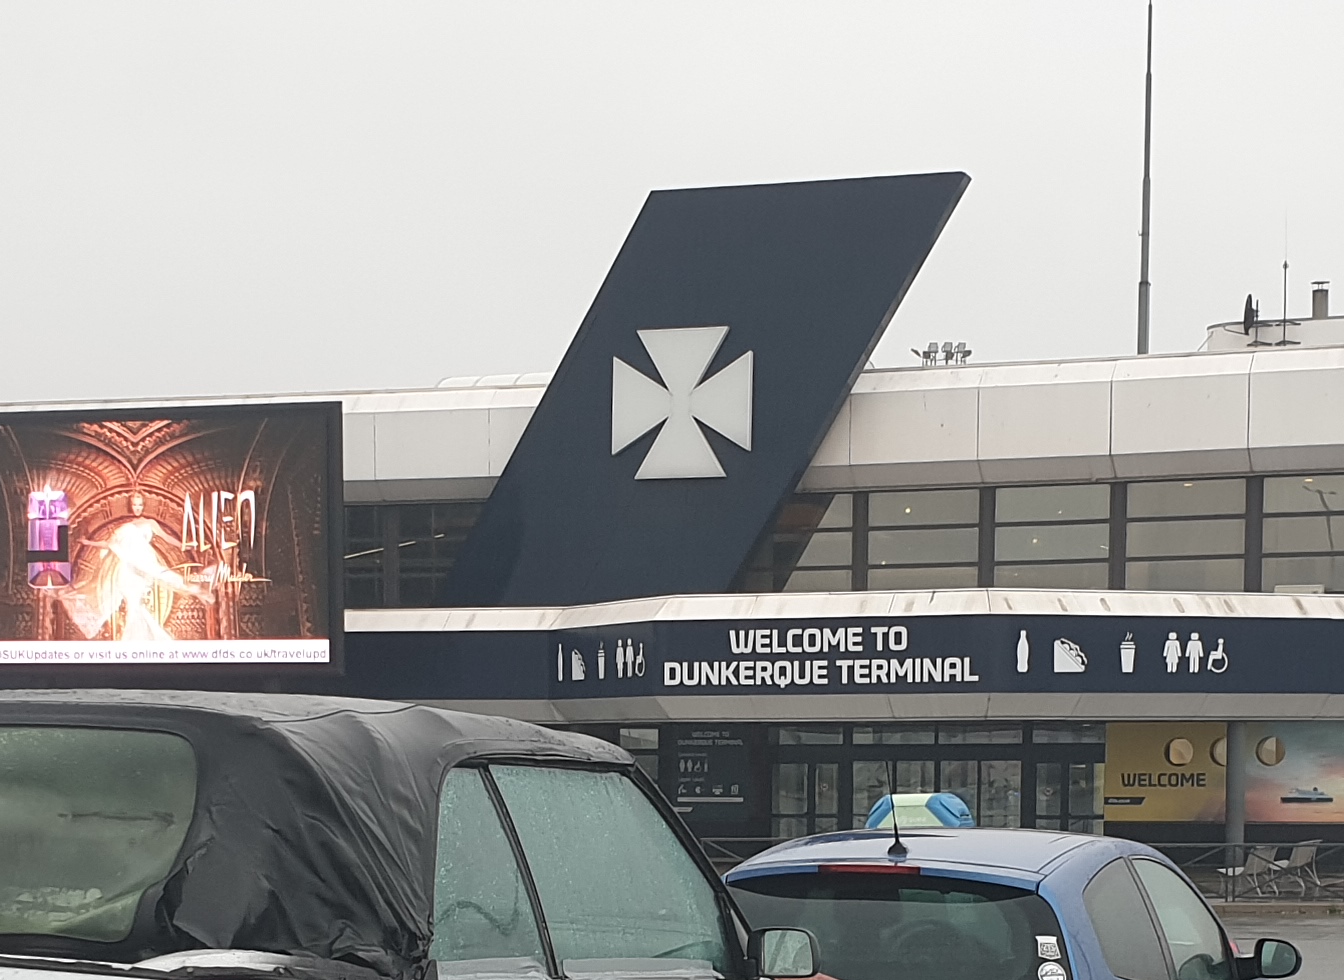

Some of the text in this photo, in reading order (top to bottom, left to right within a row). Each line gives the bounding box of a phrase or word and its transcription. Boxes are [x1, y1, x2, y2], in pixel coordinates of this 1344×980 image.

[181, 489, 256, 553] ALIEN
[729, 626, 908, 654] WELCOME TO
[74, 651, 84, 660] or
[89, 649, 112, 660] visit
[115, 651, 128, 660] us
[132, 649, 165, 660] online
[168, 649, 179, 660] at
[664, 657, 980, 689] DUNKERQUE TERMINAL
[1120, 772, 1207, 788] WELCOME
